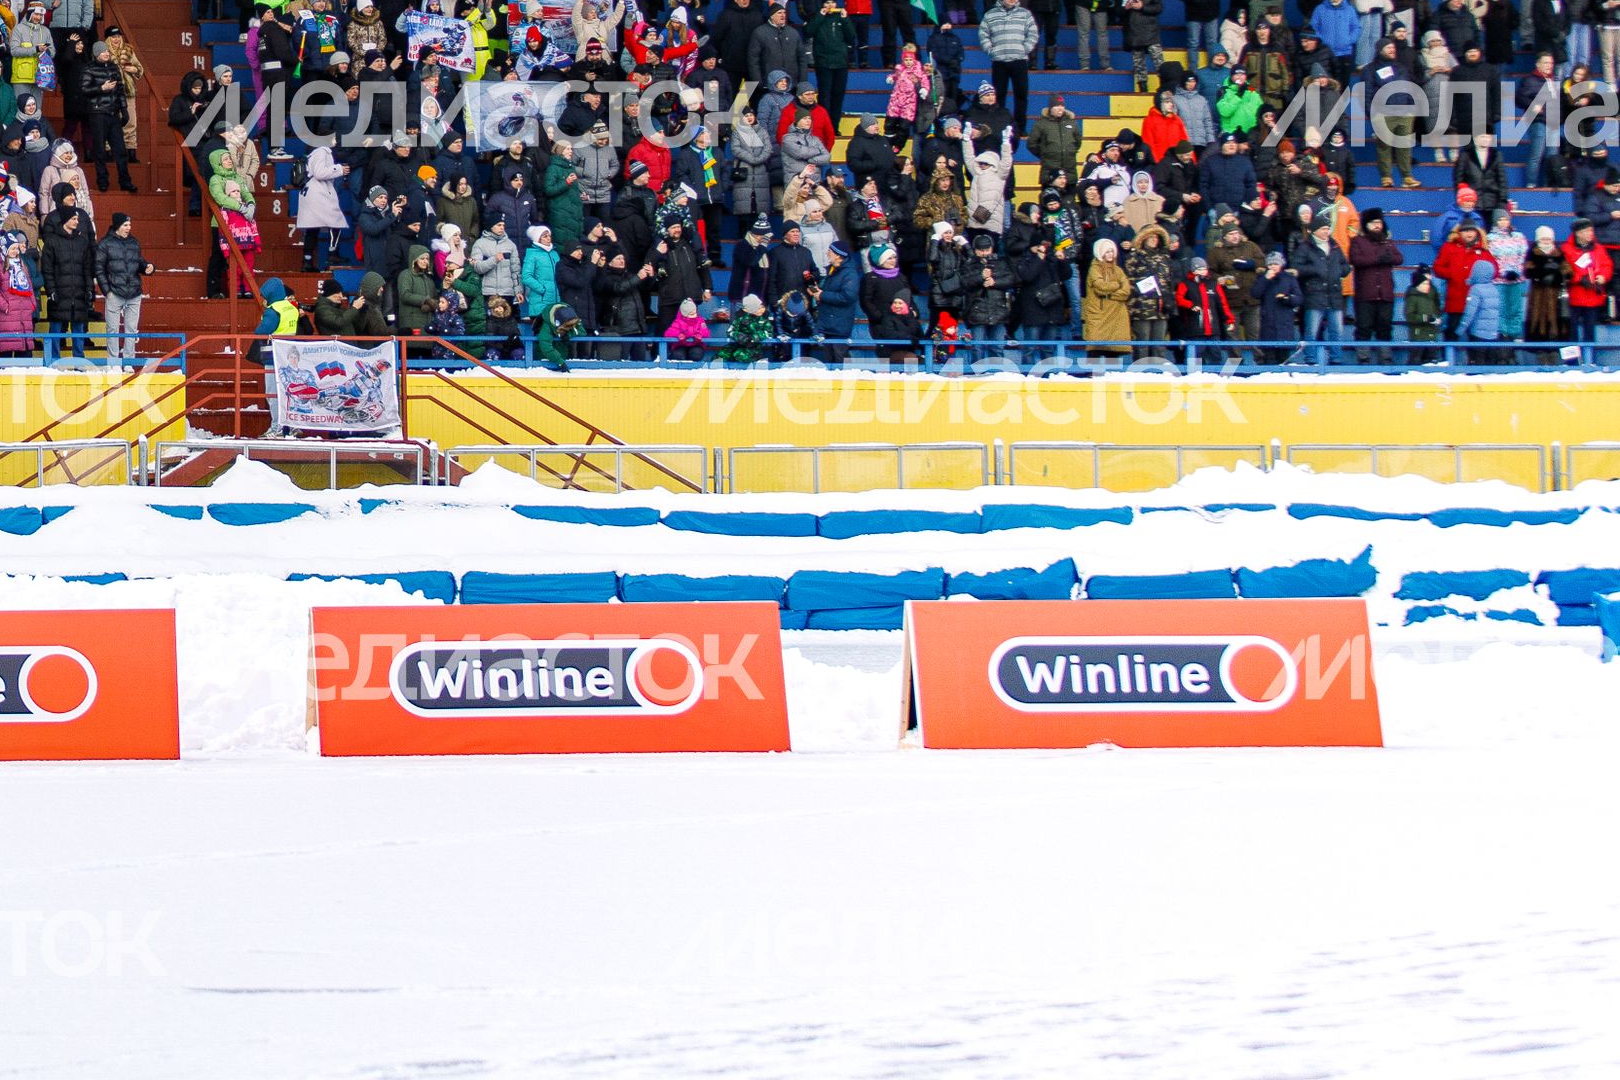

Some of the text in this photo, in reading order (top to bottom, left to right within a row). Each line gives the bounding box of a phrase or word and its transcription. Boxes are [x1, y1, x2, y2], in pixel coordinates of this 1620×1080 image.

[181, 32, 193, 47] 15
[193, 55, 205, 70] 14
[260, 173, 268, 187] 9
[273, 199, 281, 215] 8
[288, 224, 297, 238] 7
[285, 412, 345, 424] ICE SPEEDWAY
[418, 659, 615, 701] Winline
[1016, 651, 1211, 694] Winline
